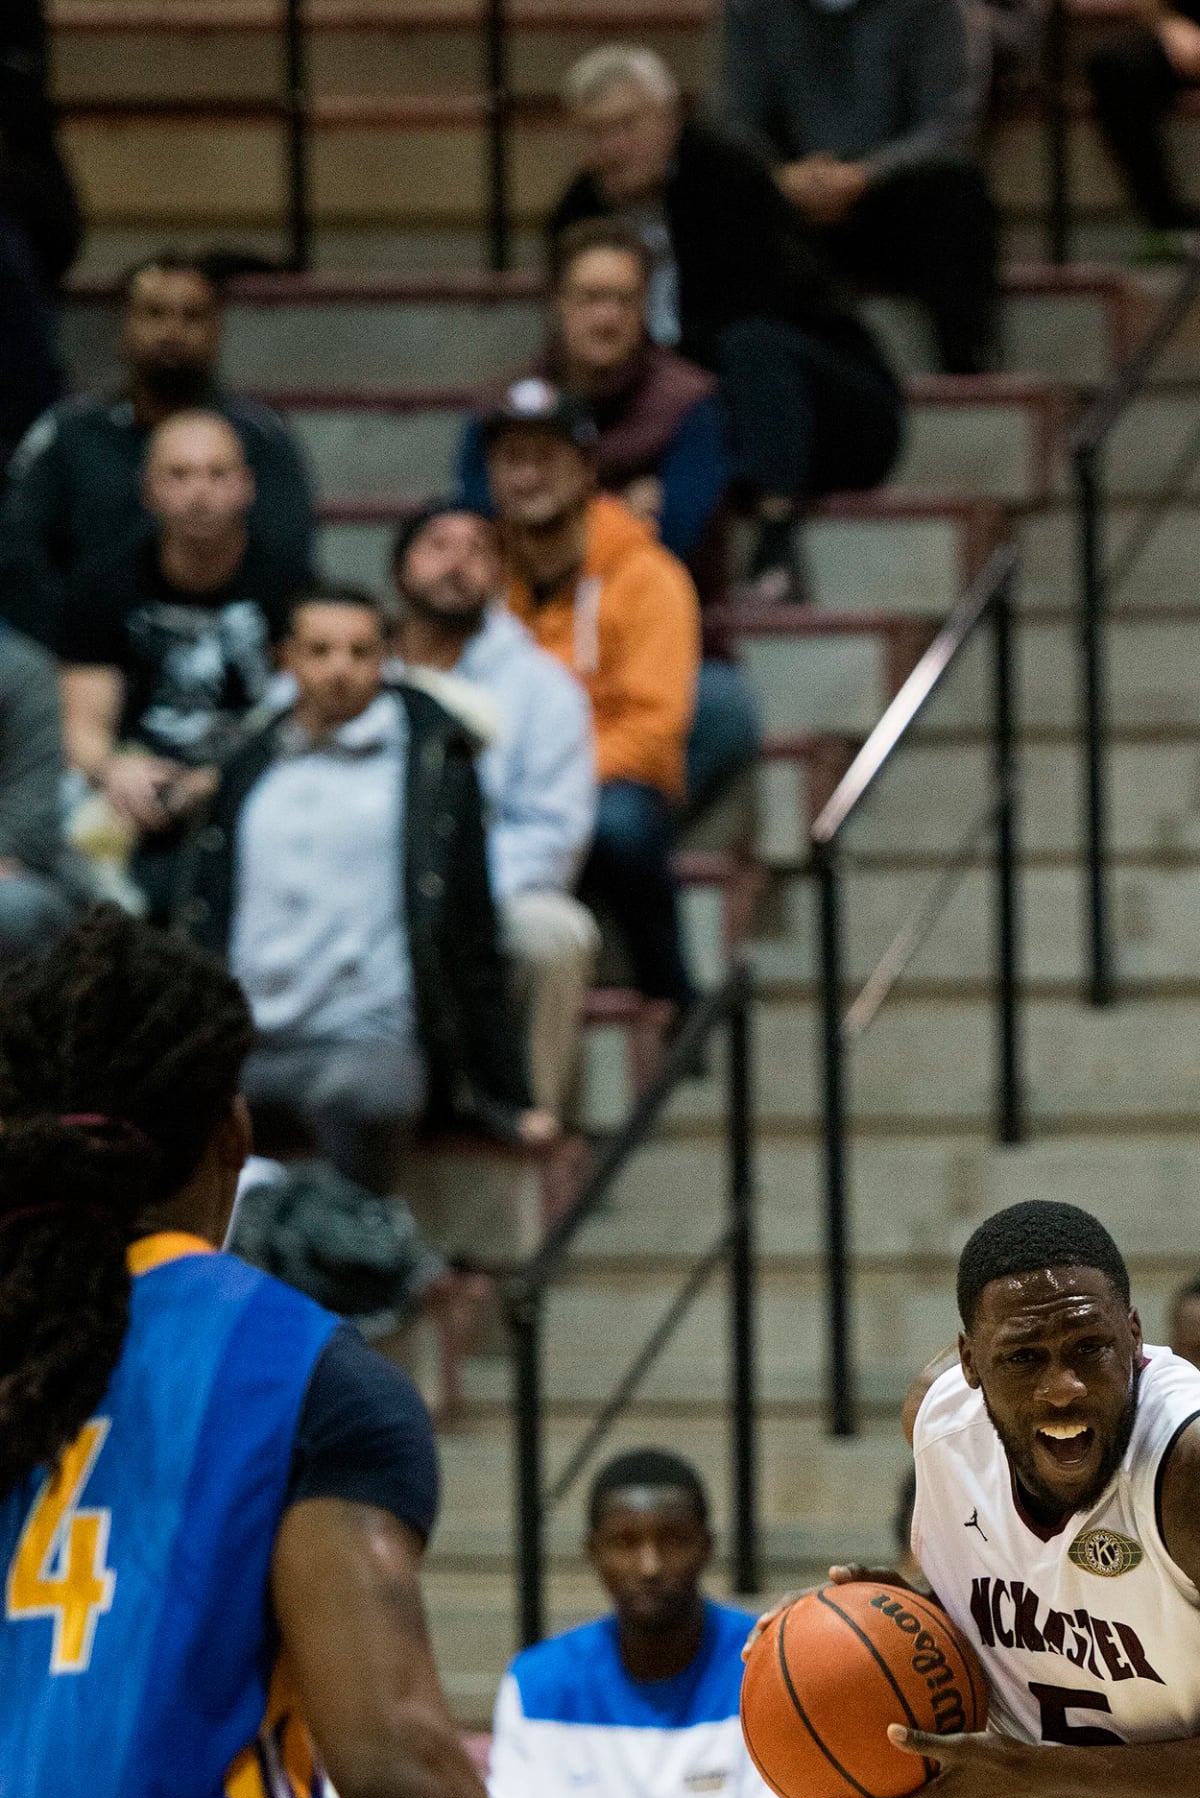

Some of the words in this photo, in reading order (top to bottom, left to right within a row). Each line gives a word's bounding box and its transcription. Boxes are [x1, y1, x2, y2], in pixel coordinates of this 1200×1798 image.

[5, 1416, 116, 1673] 4
[870, 1593, 966, 1735] Wilson
[970, 1577, 1168, 1686] MCMASTER
